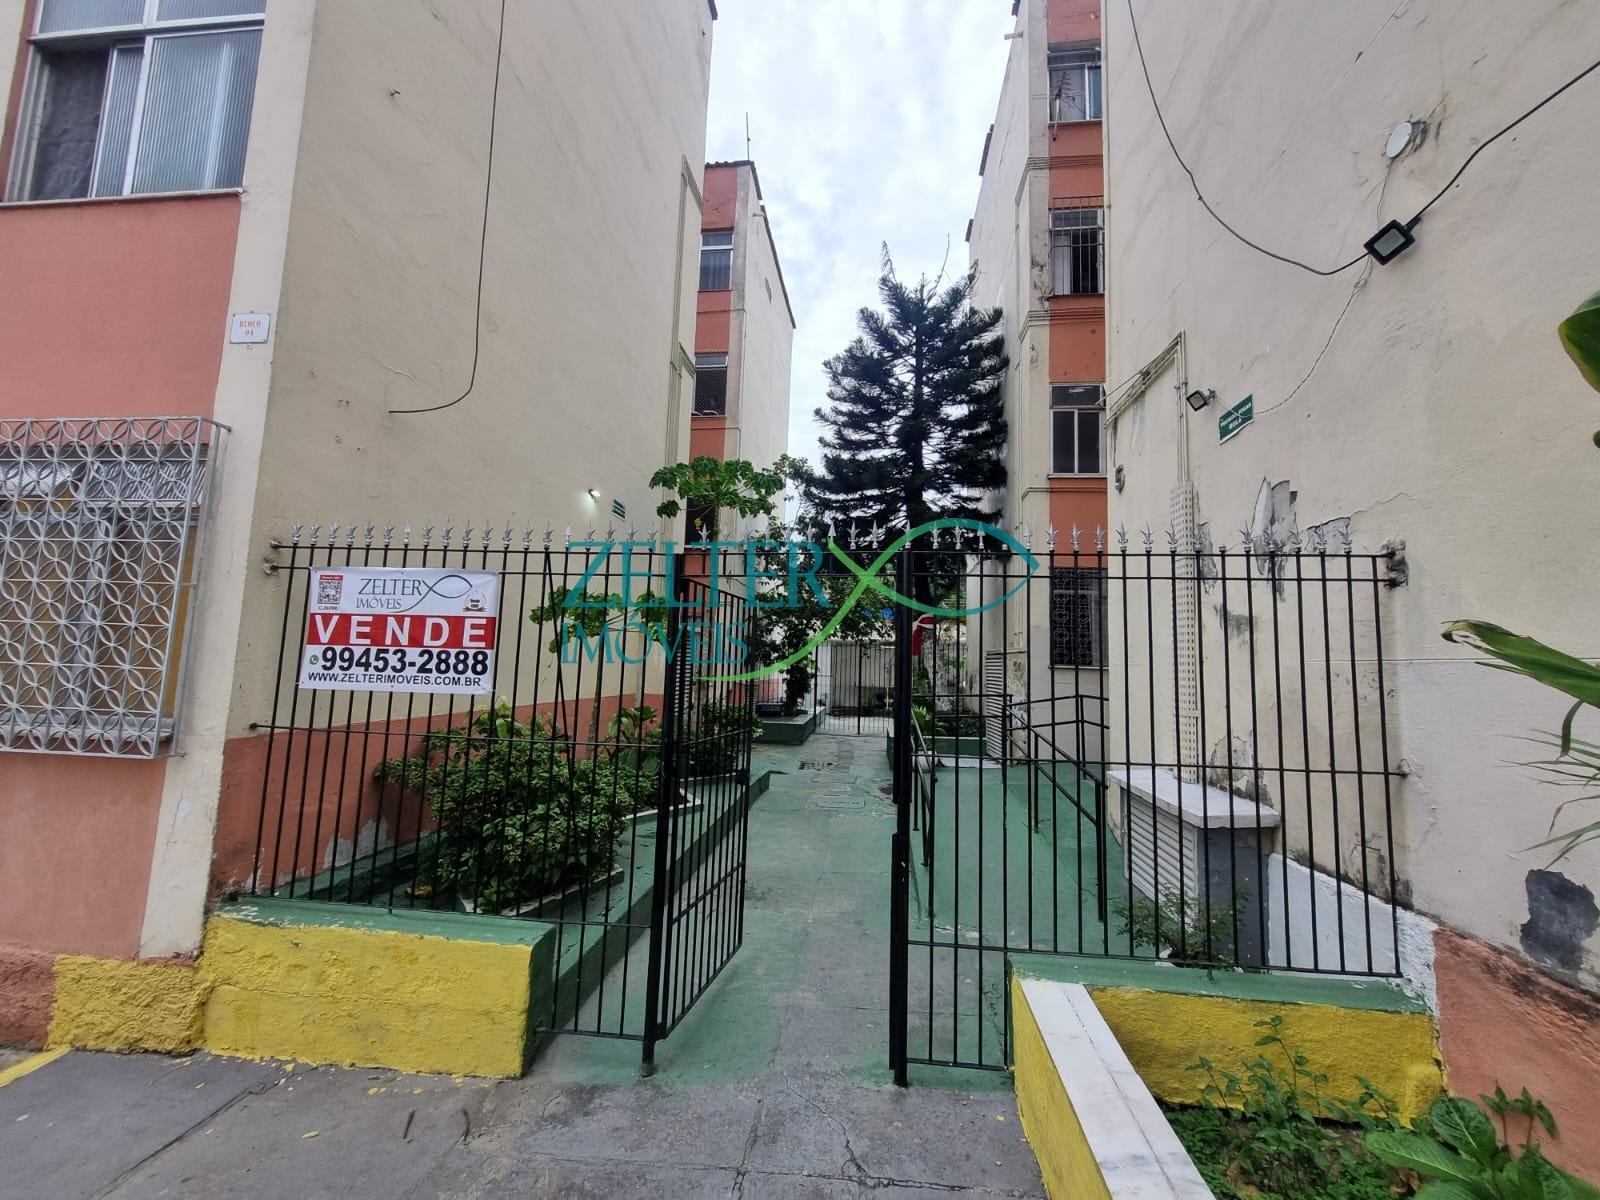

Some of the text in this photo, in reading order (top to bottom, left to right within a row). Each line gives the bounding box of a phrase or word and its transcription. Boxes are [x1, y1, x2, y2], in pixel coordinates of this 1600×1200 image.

[358, 578, 422, 596] ZELTER
[356, 596, 402, 609] IMÓVEIS
[314, 614, 487, 648] VENDE
[321, 646, 488, 676] 99453-2888
[308, 672, 481, 687] WWW.ZELTERIMOVEIS.COM.BR
